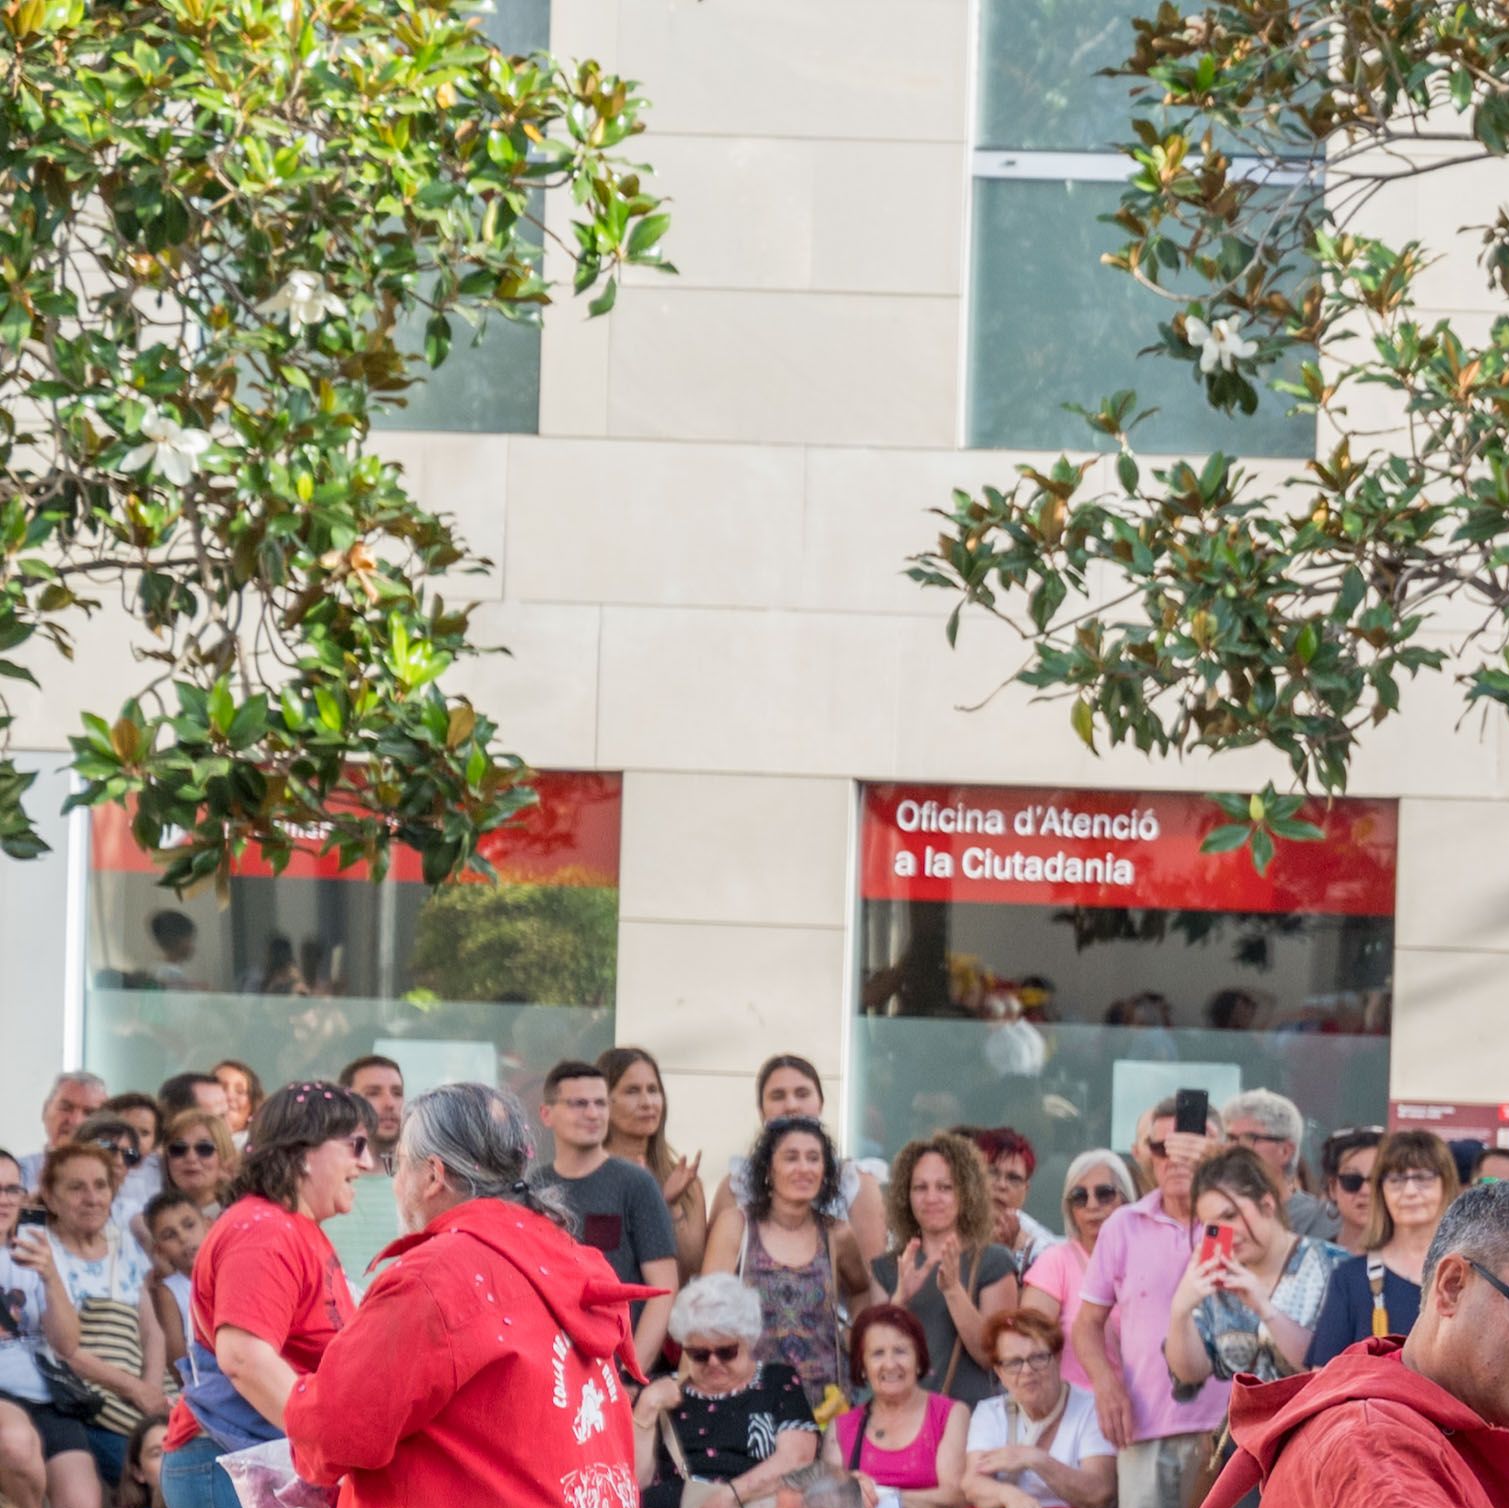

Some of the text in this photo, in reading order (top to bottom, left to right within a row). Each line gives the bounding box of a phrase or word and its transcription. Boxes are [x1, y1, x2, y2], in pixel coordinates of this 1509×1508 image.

[896, 800, 1161, 841] Oficina d'Atenció
[893, 845, 1136, 886] a la Ciutadania
